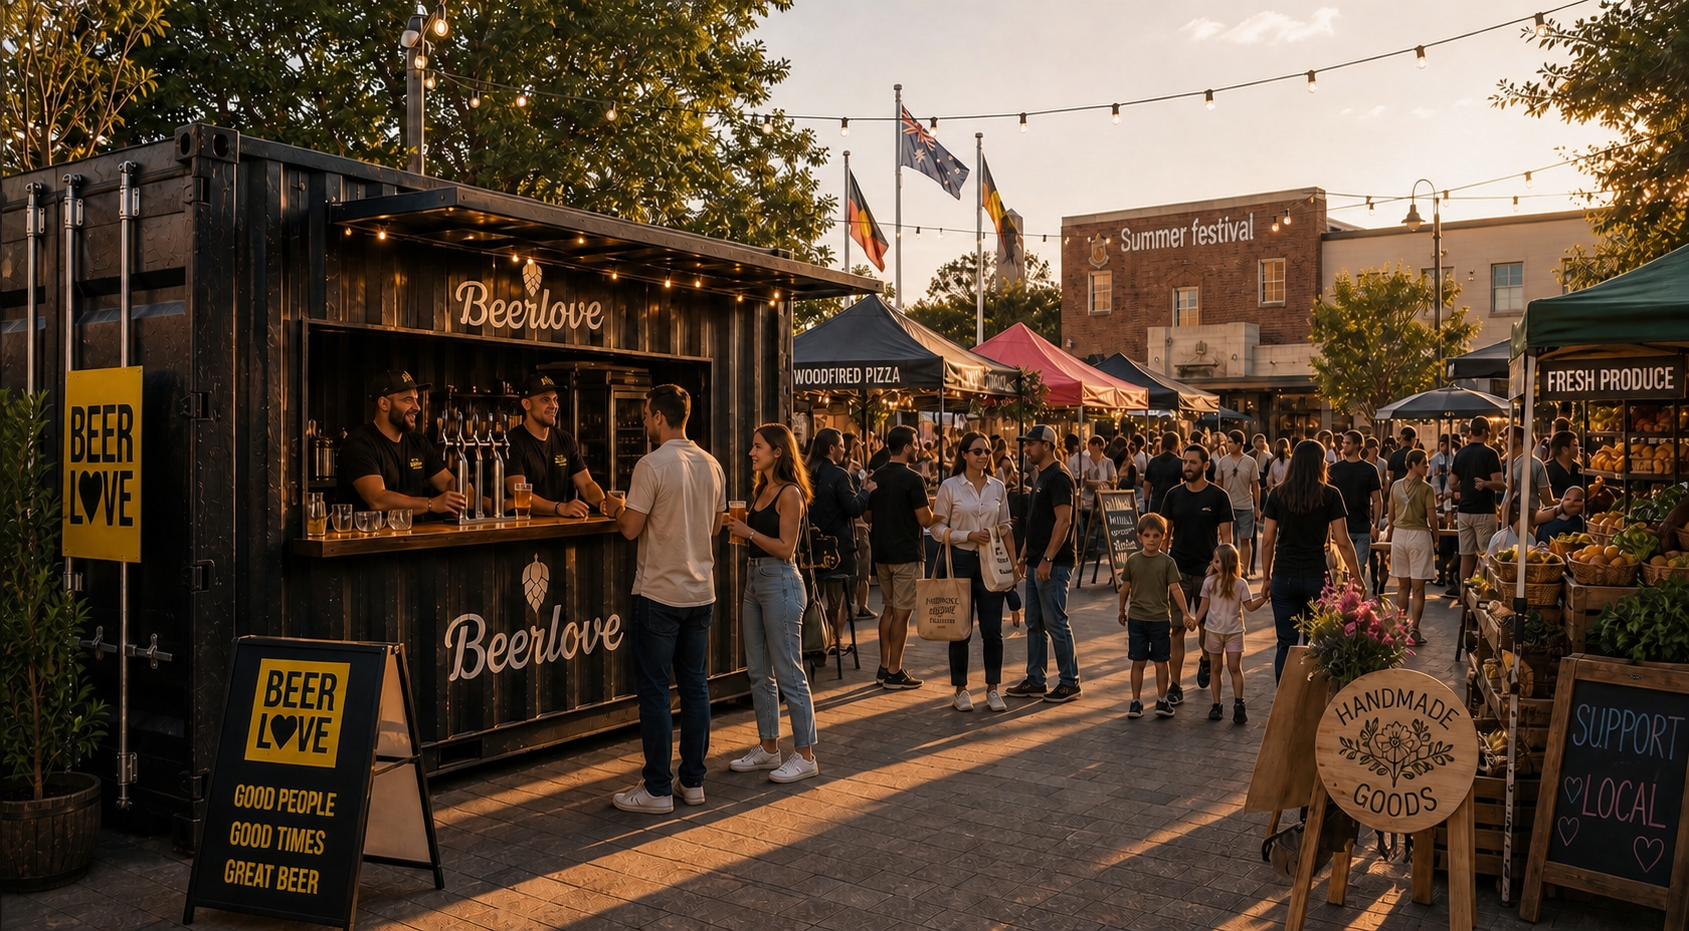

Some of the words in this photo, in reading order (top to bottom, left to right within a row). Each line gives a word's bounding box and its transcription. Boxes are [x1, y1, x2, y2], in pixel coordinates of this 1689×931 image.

[1120, 226, 1187, 252] Summer
[1192, 212, 1254, 247] festival
[455, 280, 605, 330] Beerlove
[794, 367, 862, 385] WOODFIRED
[865, 366, 901, 383] PIZZA
[1547, 369, 1595, 392] FRESH
[1600, 366, 1675, 391] PRODUCE
[70, 403, 134, 464] BEER
[444, 604, 624, 682] Beerlove
[263, 669, 338, 712] BEER
[1334, 687, 1461, 731] HANDMADE
[1572, 703, 1686, 761] SUPPORT
[233, 783, 275, 811] GOOD
[277, 788, 337, 817] PEOPLE
[1353, 782, 1438, 818] GOODS
[1582, 774, 1666, 829] LOCAL
[229, 821, 272, 849] GOOD
[277, 826, 326, 856] TIMES
[224, 859, 274, 889] GREAT
[276, 866, 319, 895] BEER
